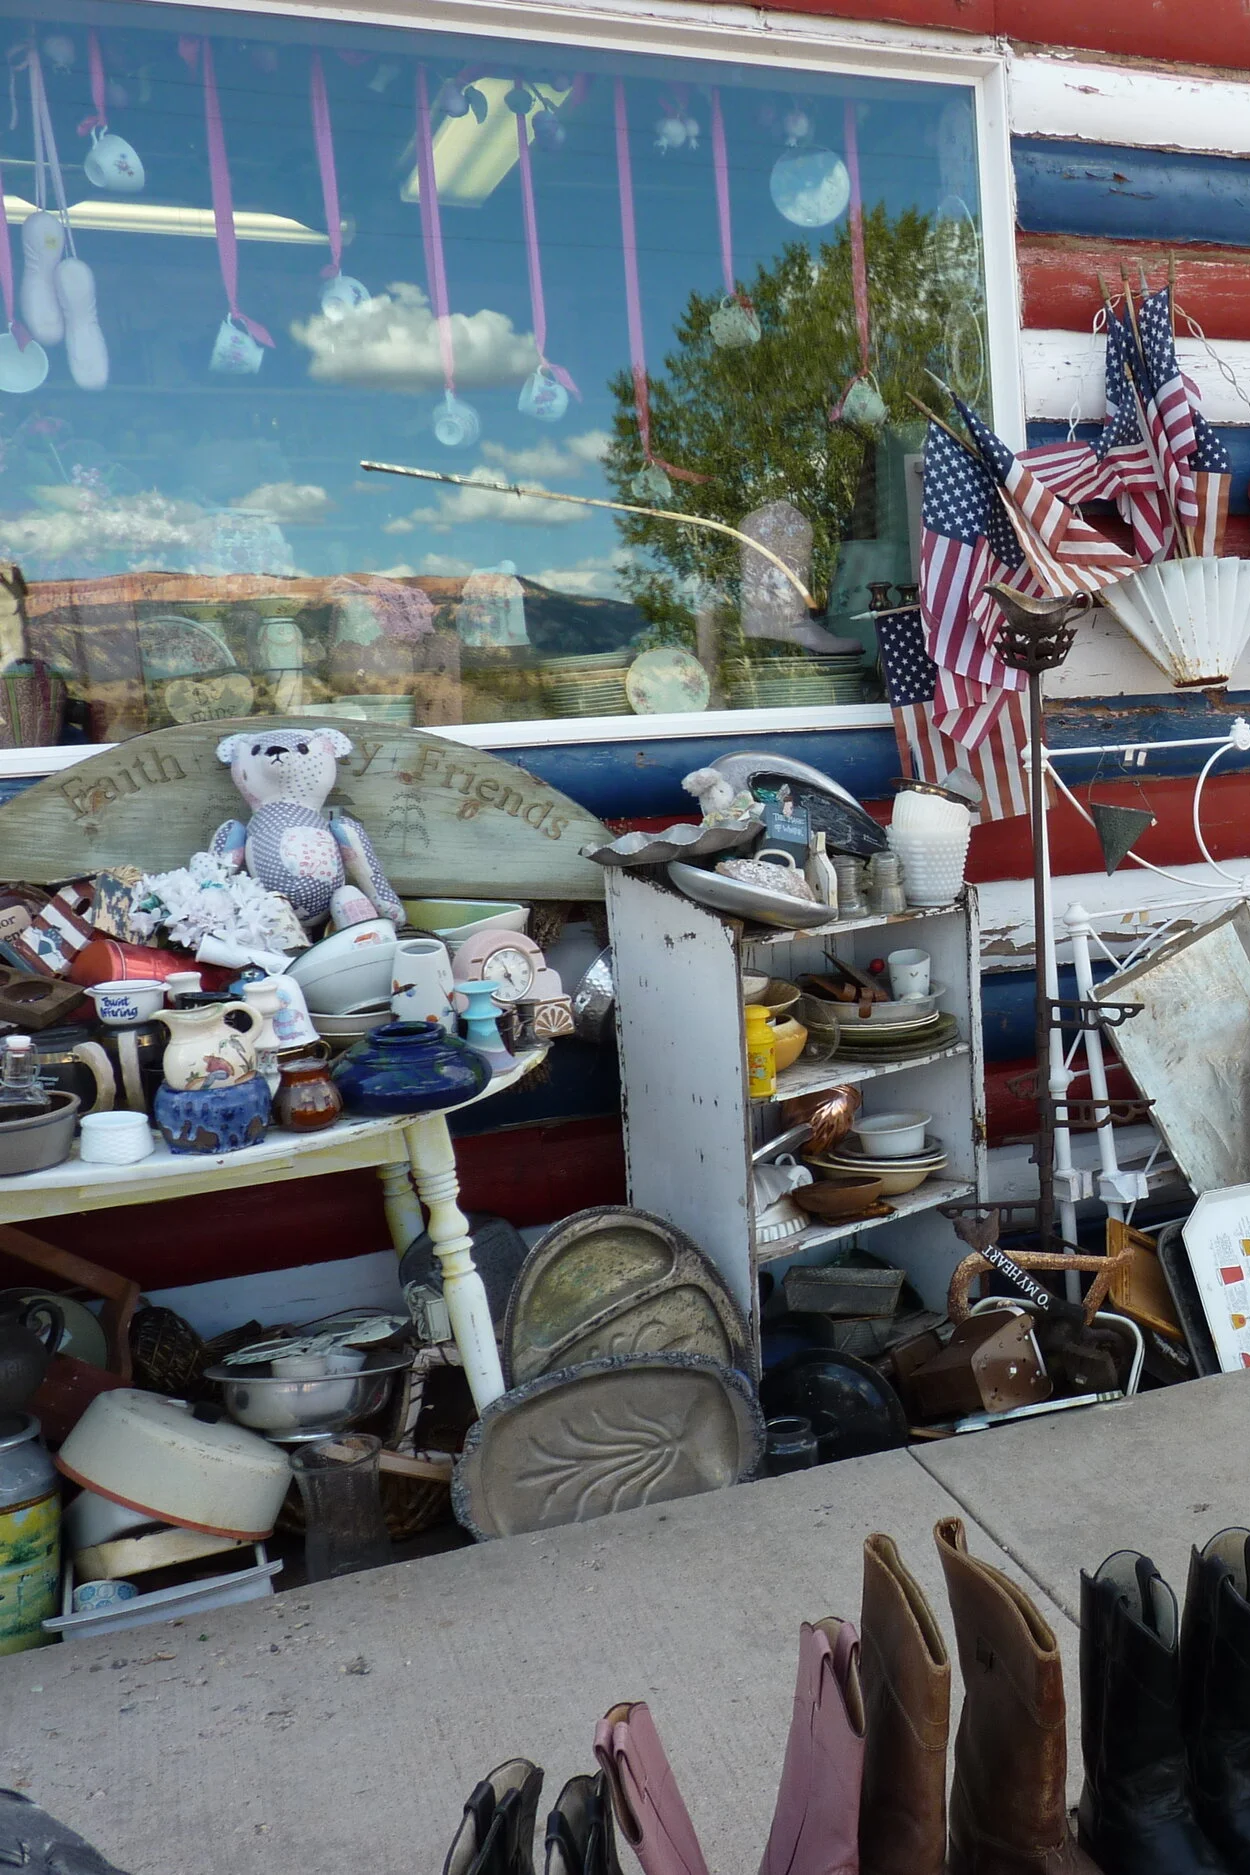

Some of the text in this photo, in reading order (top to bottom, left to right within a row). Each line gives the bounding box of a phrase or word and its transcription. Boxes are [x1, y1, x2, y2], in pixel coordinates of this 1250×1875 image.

[60, 746, 188, 822] Faith
[413, 743, 570, 840] Friends
[981, 1244, 1023, 1282] HEART
[1016, 1275, 1040, 1297] MY
